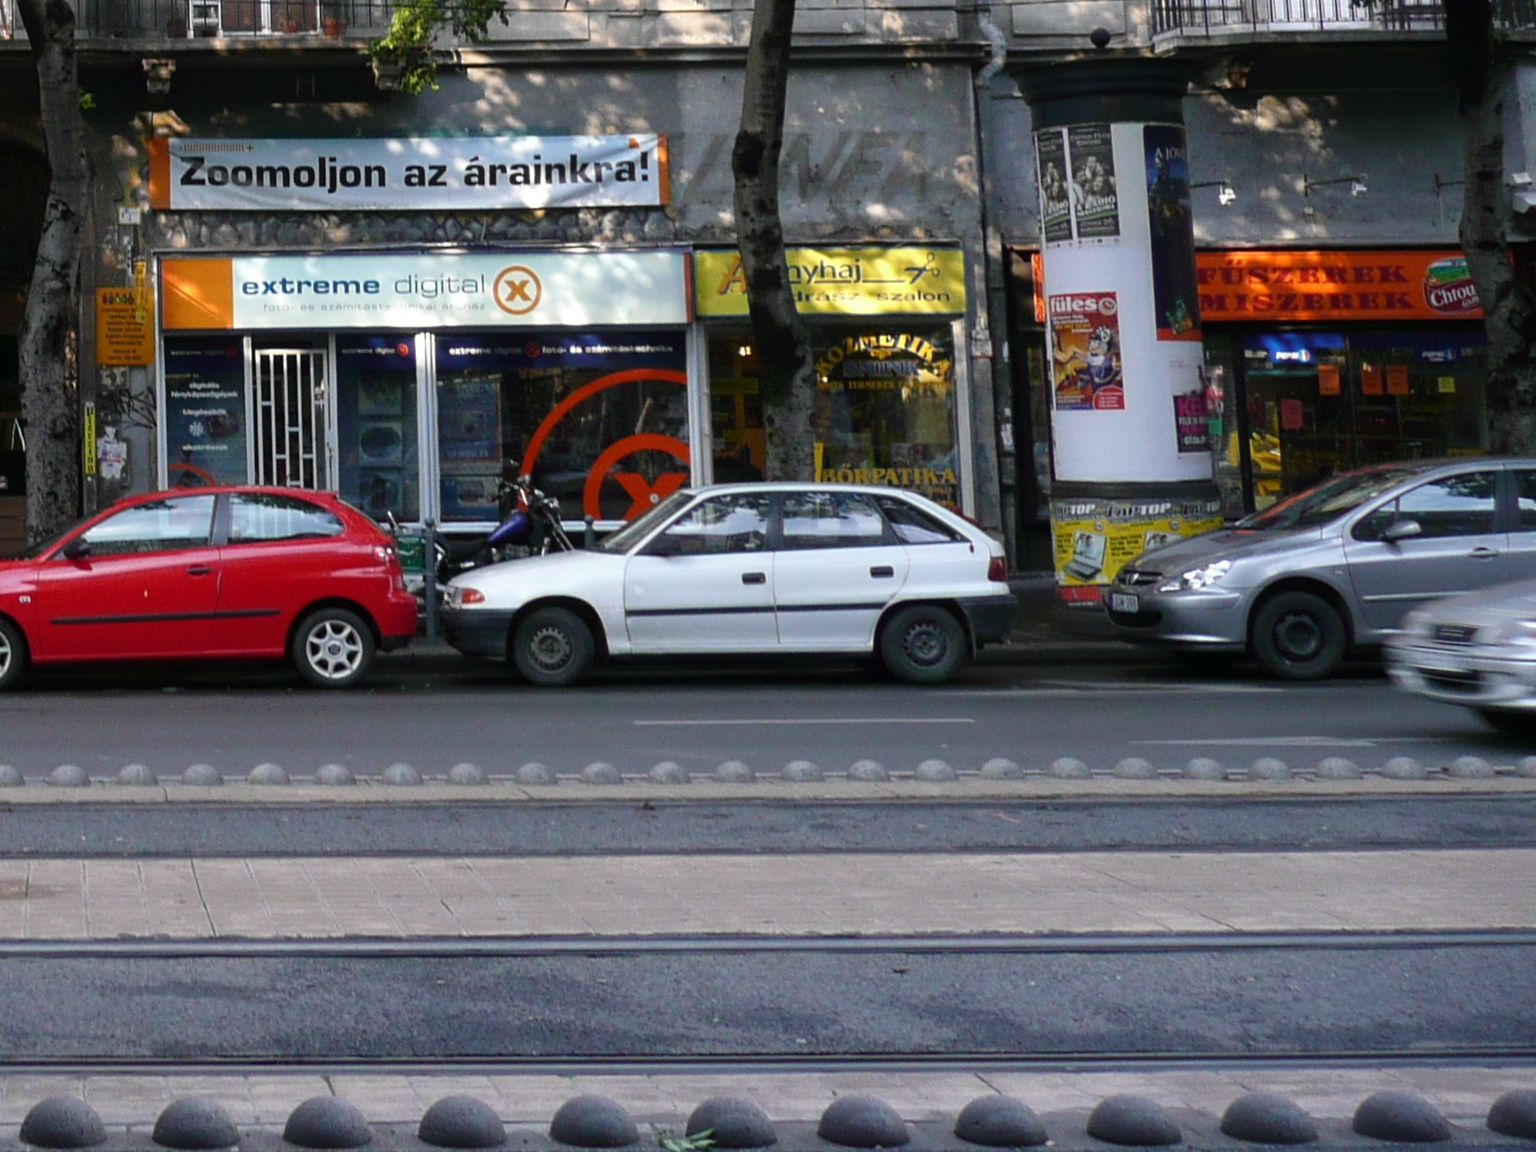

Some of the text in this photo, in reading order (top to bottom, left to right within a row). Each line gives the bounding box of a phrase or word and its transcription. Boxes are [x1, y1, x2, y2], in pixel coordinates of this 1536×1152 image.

[180, 151, 650, 194] Zoomoljon az árainkra!
[241, 276, 380, 295] extreme
[394, 273, 486, 298] digital
[719, 258, 861, 295] Anyhaj
[876, 289, 951, 303] szalon
[1049, 296, 1098, 316] füles
[1199, 292, 1416, 311] MISZEREK
[1430, 284, 1476, 307] Chtou
[300, 302, 315, 313] és
[822, 462, 957, 485] BŐRPATIKA
